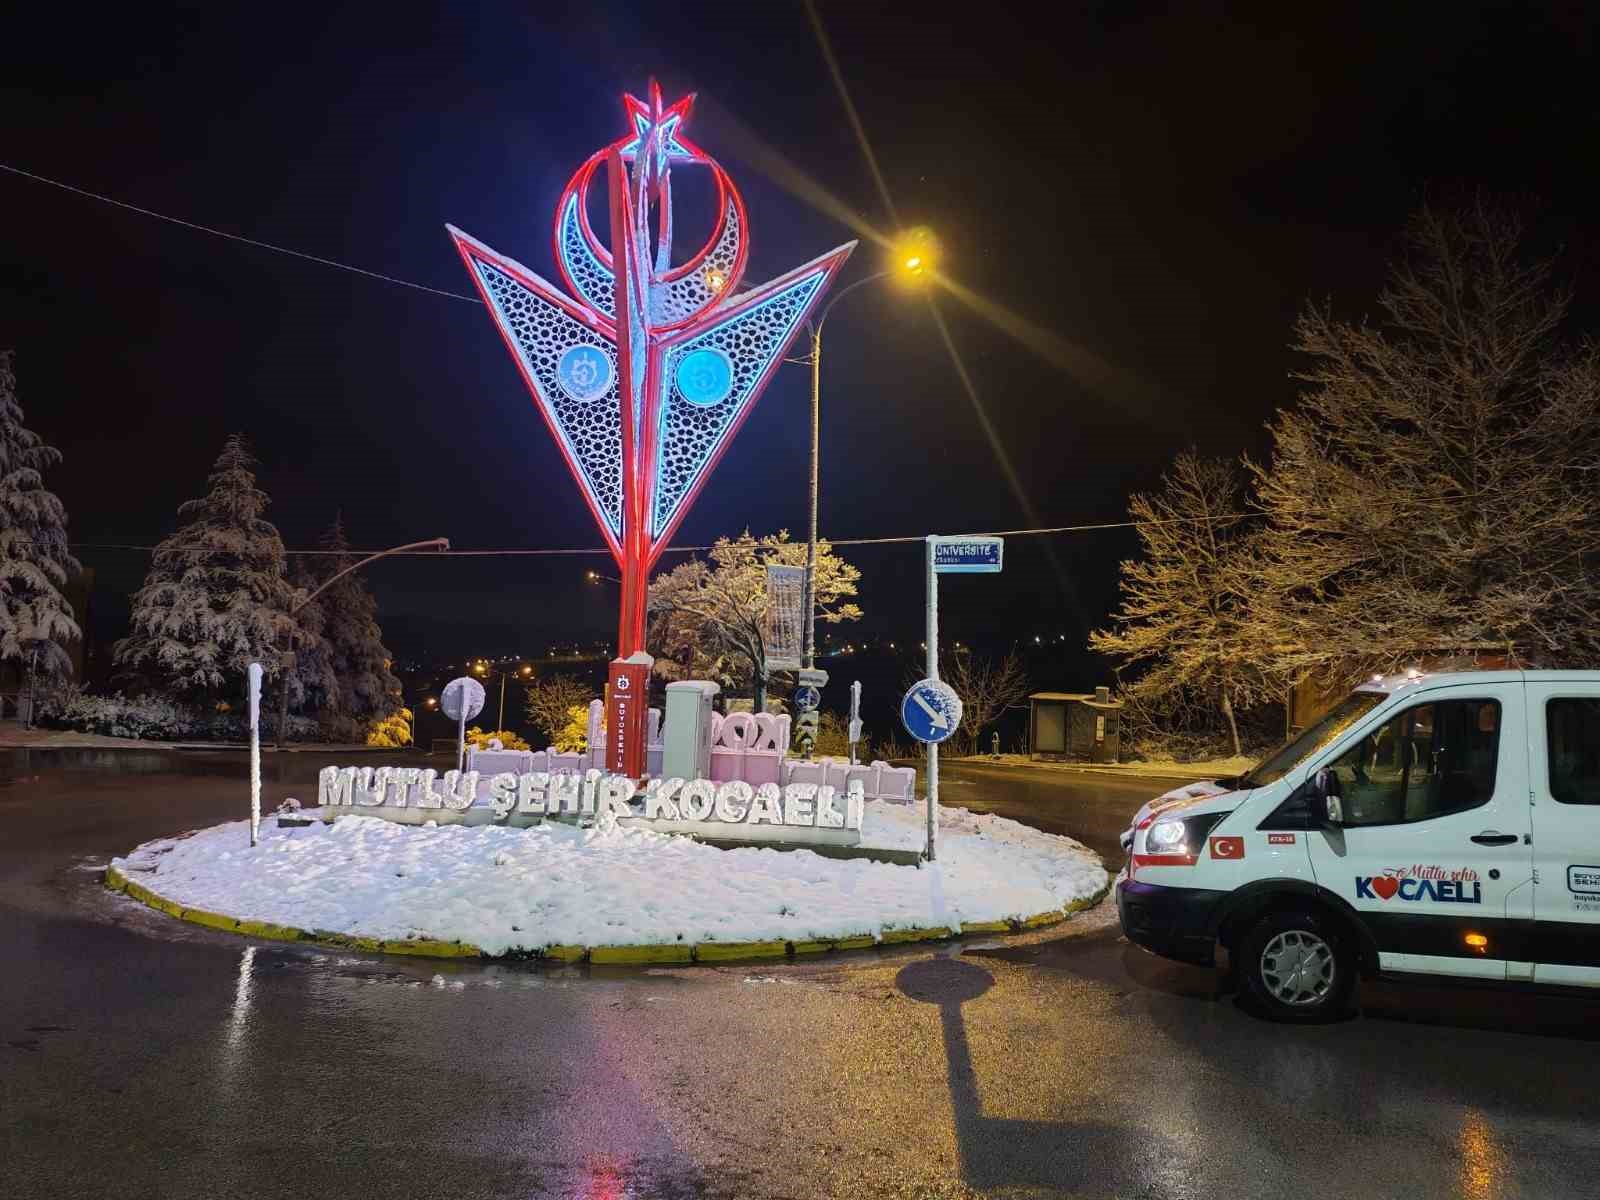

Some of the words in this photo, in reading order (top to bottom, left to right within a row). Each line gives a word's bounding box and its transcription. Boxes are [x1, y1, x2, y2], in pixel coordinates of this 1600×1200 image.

[318, 766, 479, 809] MUTLU
[488, 768, 636, 819] ŞEHİR
[644, 778, 865, 829] KOCAELİ
